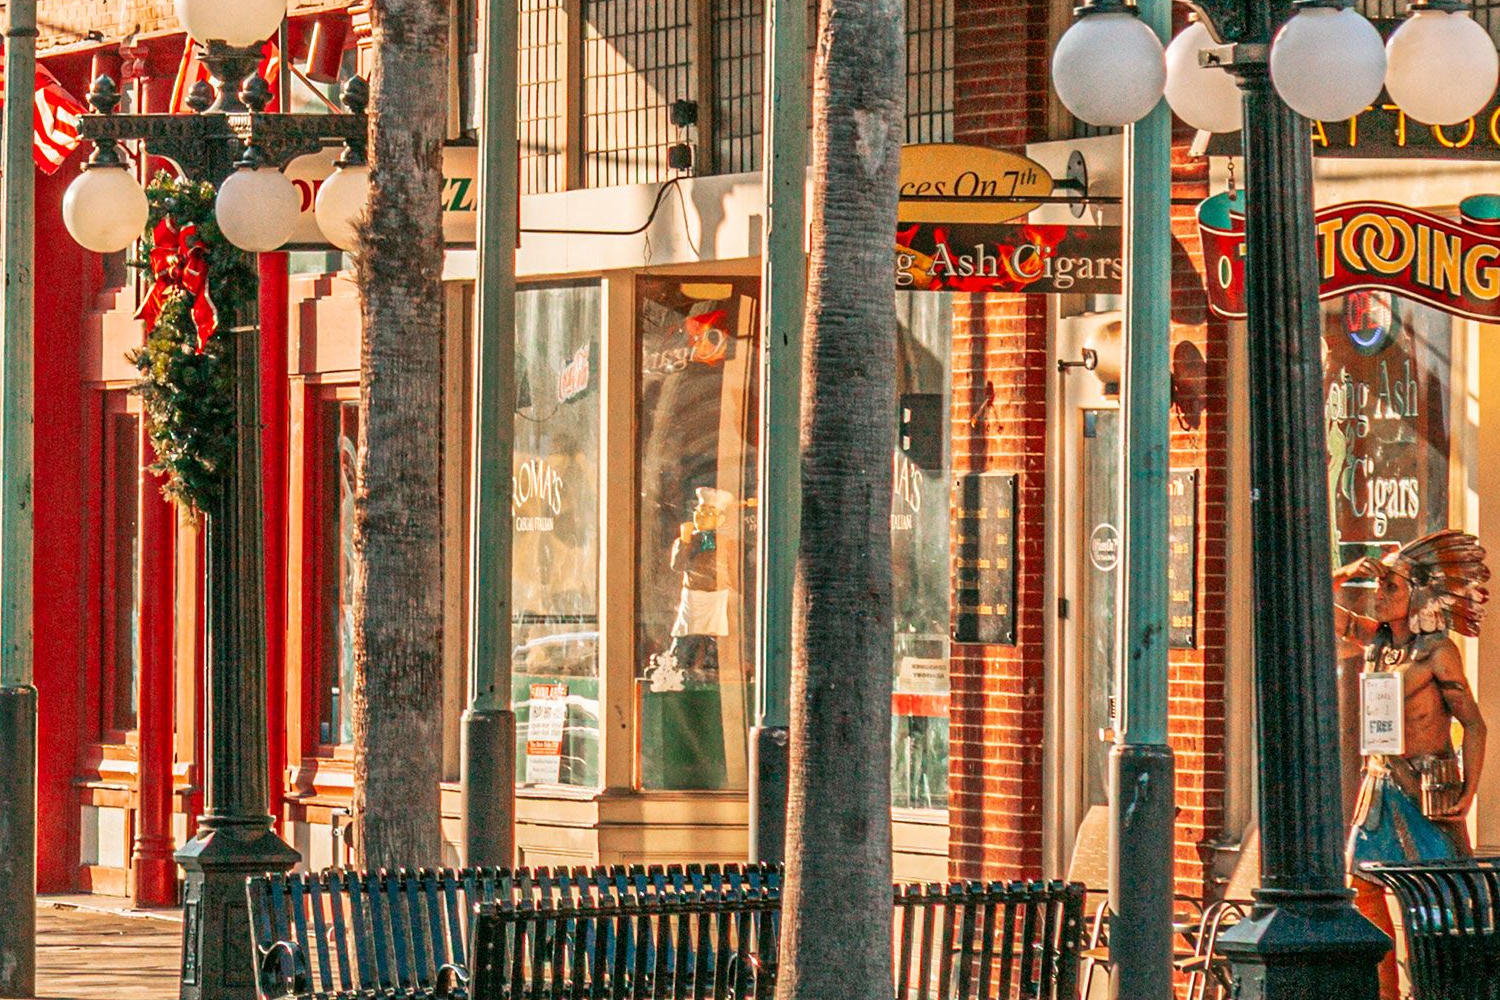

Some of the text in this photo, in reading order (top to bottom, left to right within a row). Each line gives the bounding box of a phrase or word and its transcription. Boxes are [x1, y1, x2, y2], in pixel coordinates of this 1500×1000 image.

[954, 171, 996, 196] On
[1003, 168, 1037, 196] 7th
[927, 243, 998, 277] Ash
[1010, 243, 1122, 290] Cigars
[1374, 360, 1418, 419] Ash
[1342, 457, 1420, 537] Cigars
[1370, 720, 1393, 734] FREE
